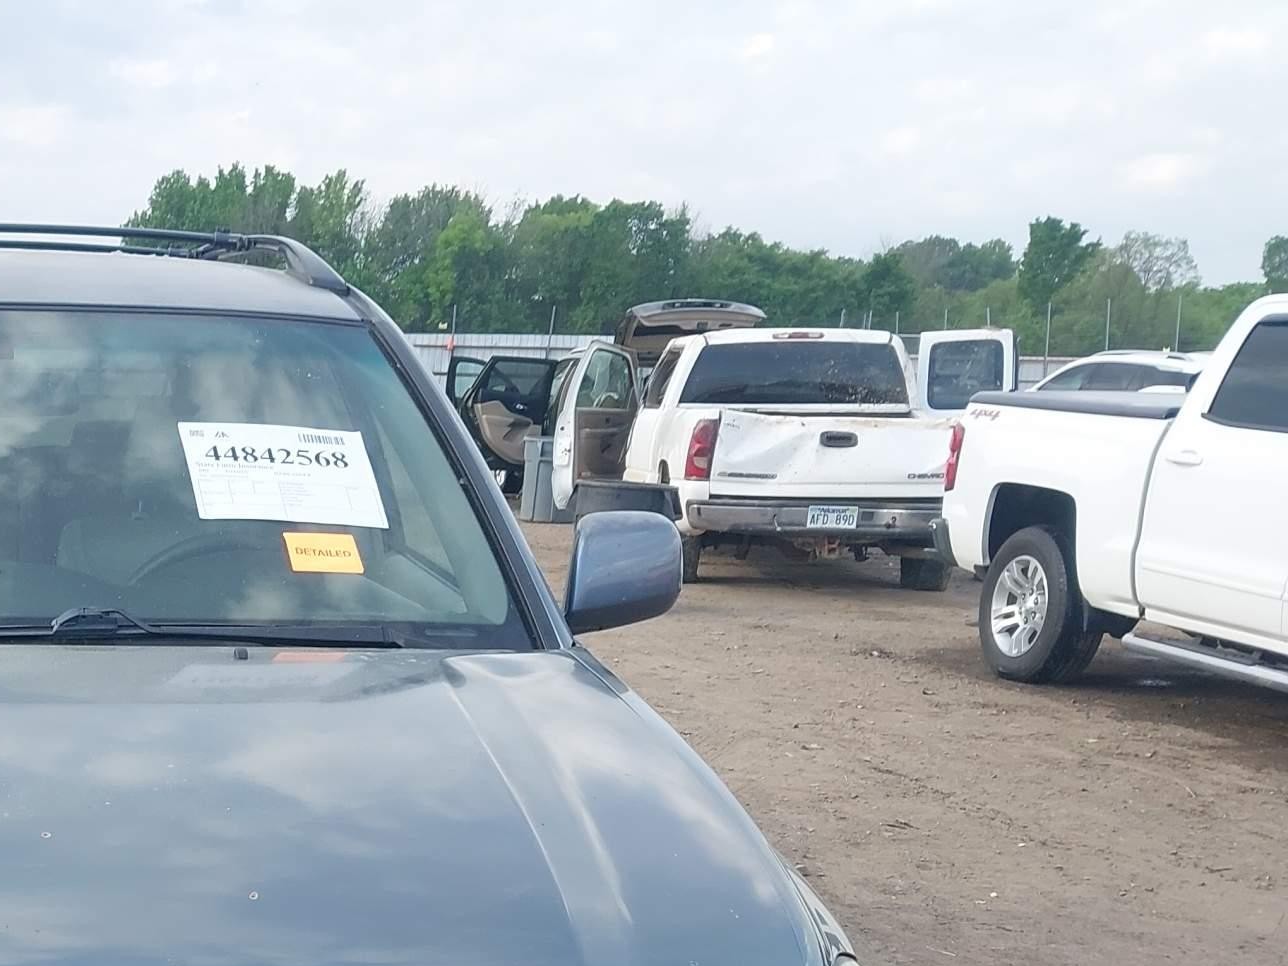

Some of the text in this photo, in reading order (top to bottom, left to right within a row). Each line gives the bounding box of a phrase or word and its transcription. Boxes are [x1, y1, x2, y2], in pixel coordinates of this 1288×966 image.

[205, 445, 349, 469] 44842568
[809, 514, 829, 525] AFD
[295, 546, 352, 558] DETAILED
